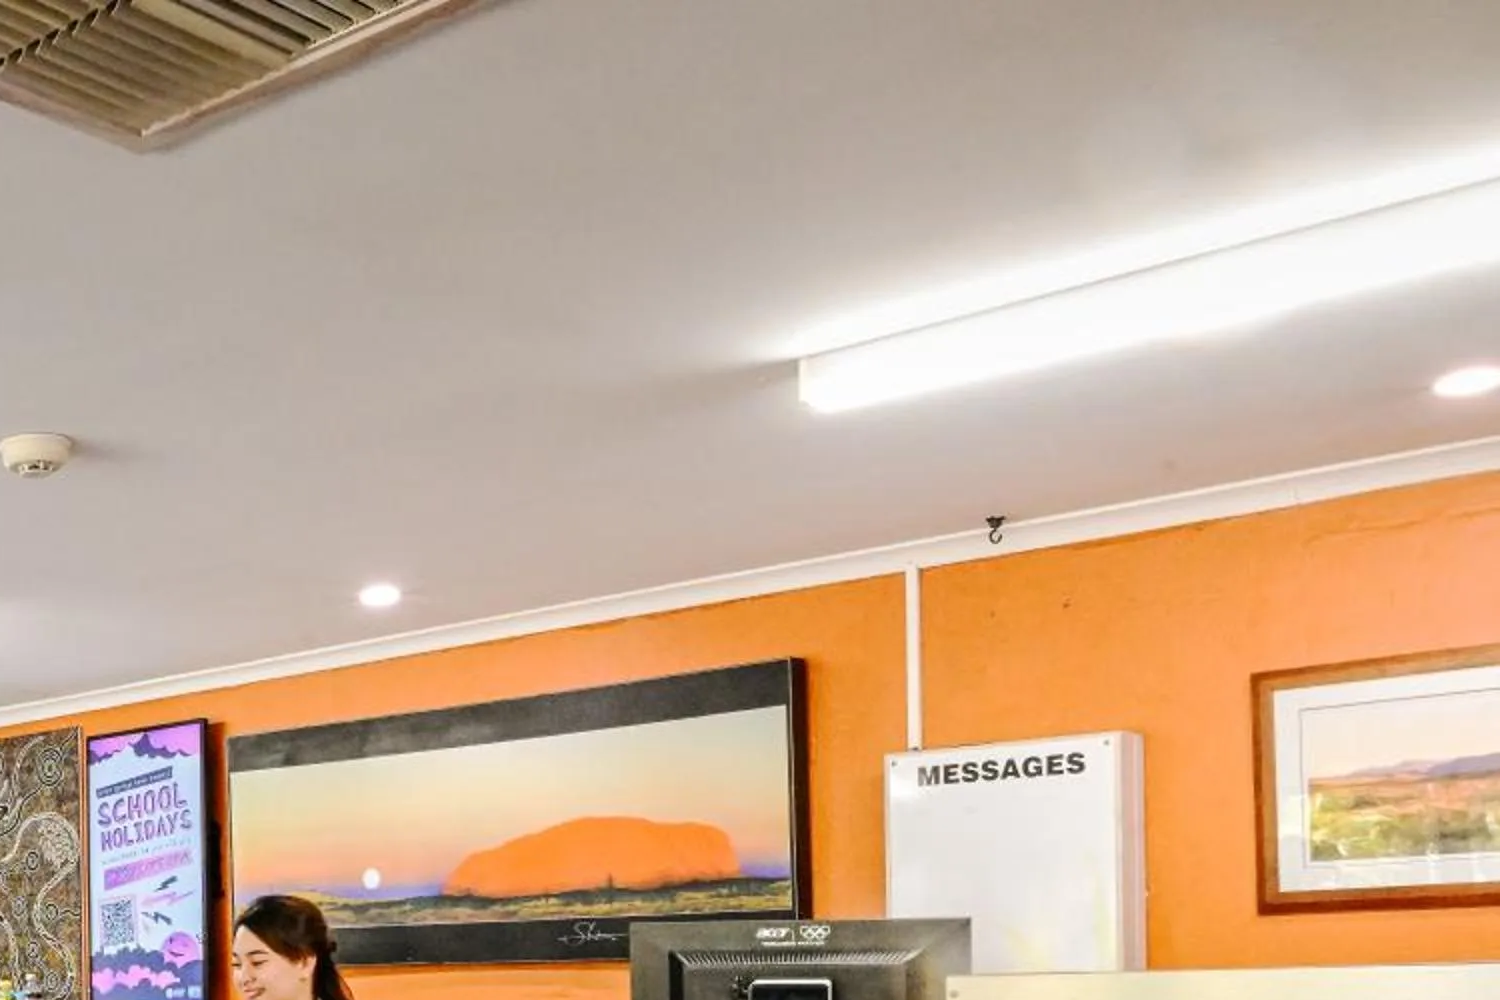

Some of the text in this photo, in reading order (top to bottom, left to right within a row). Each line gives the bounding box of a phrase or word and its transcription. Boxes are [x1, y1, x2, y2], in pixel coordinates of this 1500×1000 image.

[917, 752, 1086, 787] MESSAGES
[97, 782, 188, 826] SCHOOL
[100, 809, 192, 852] HOLIDAYS
